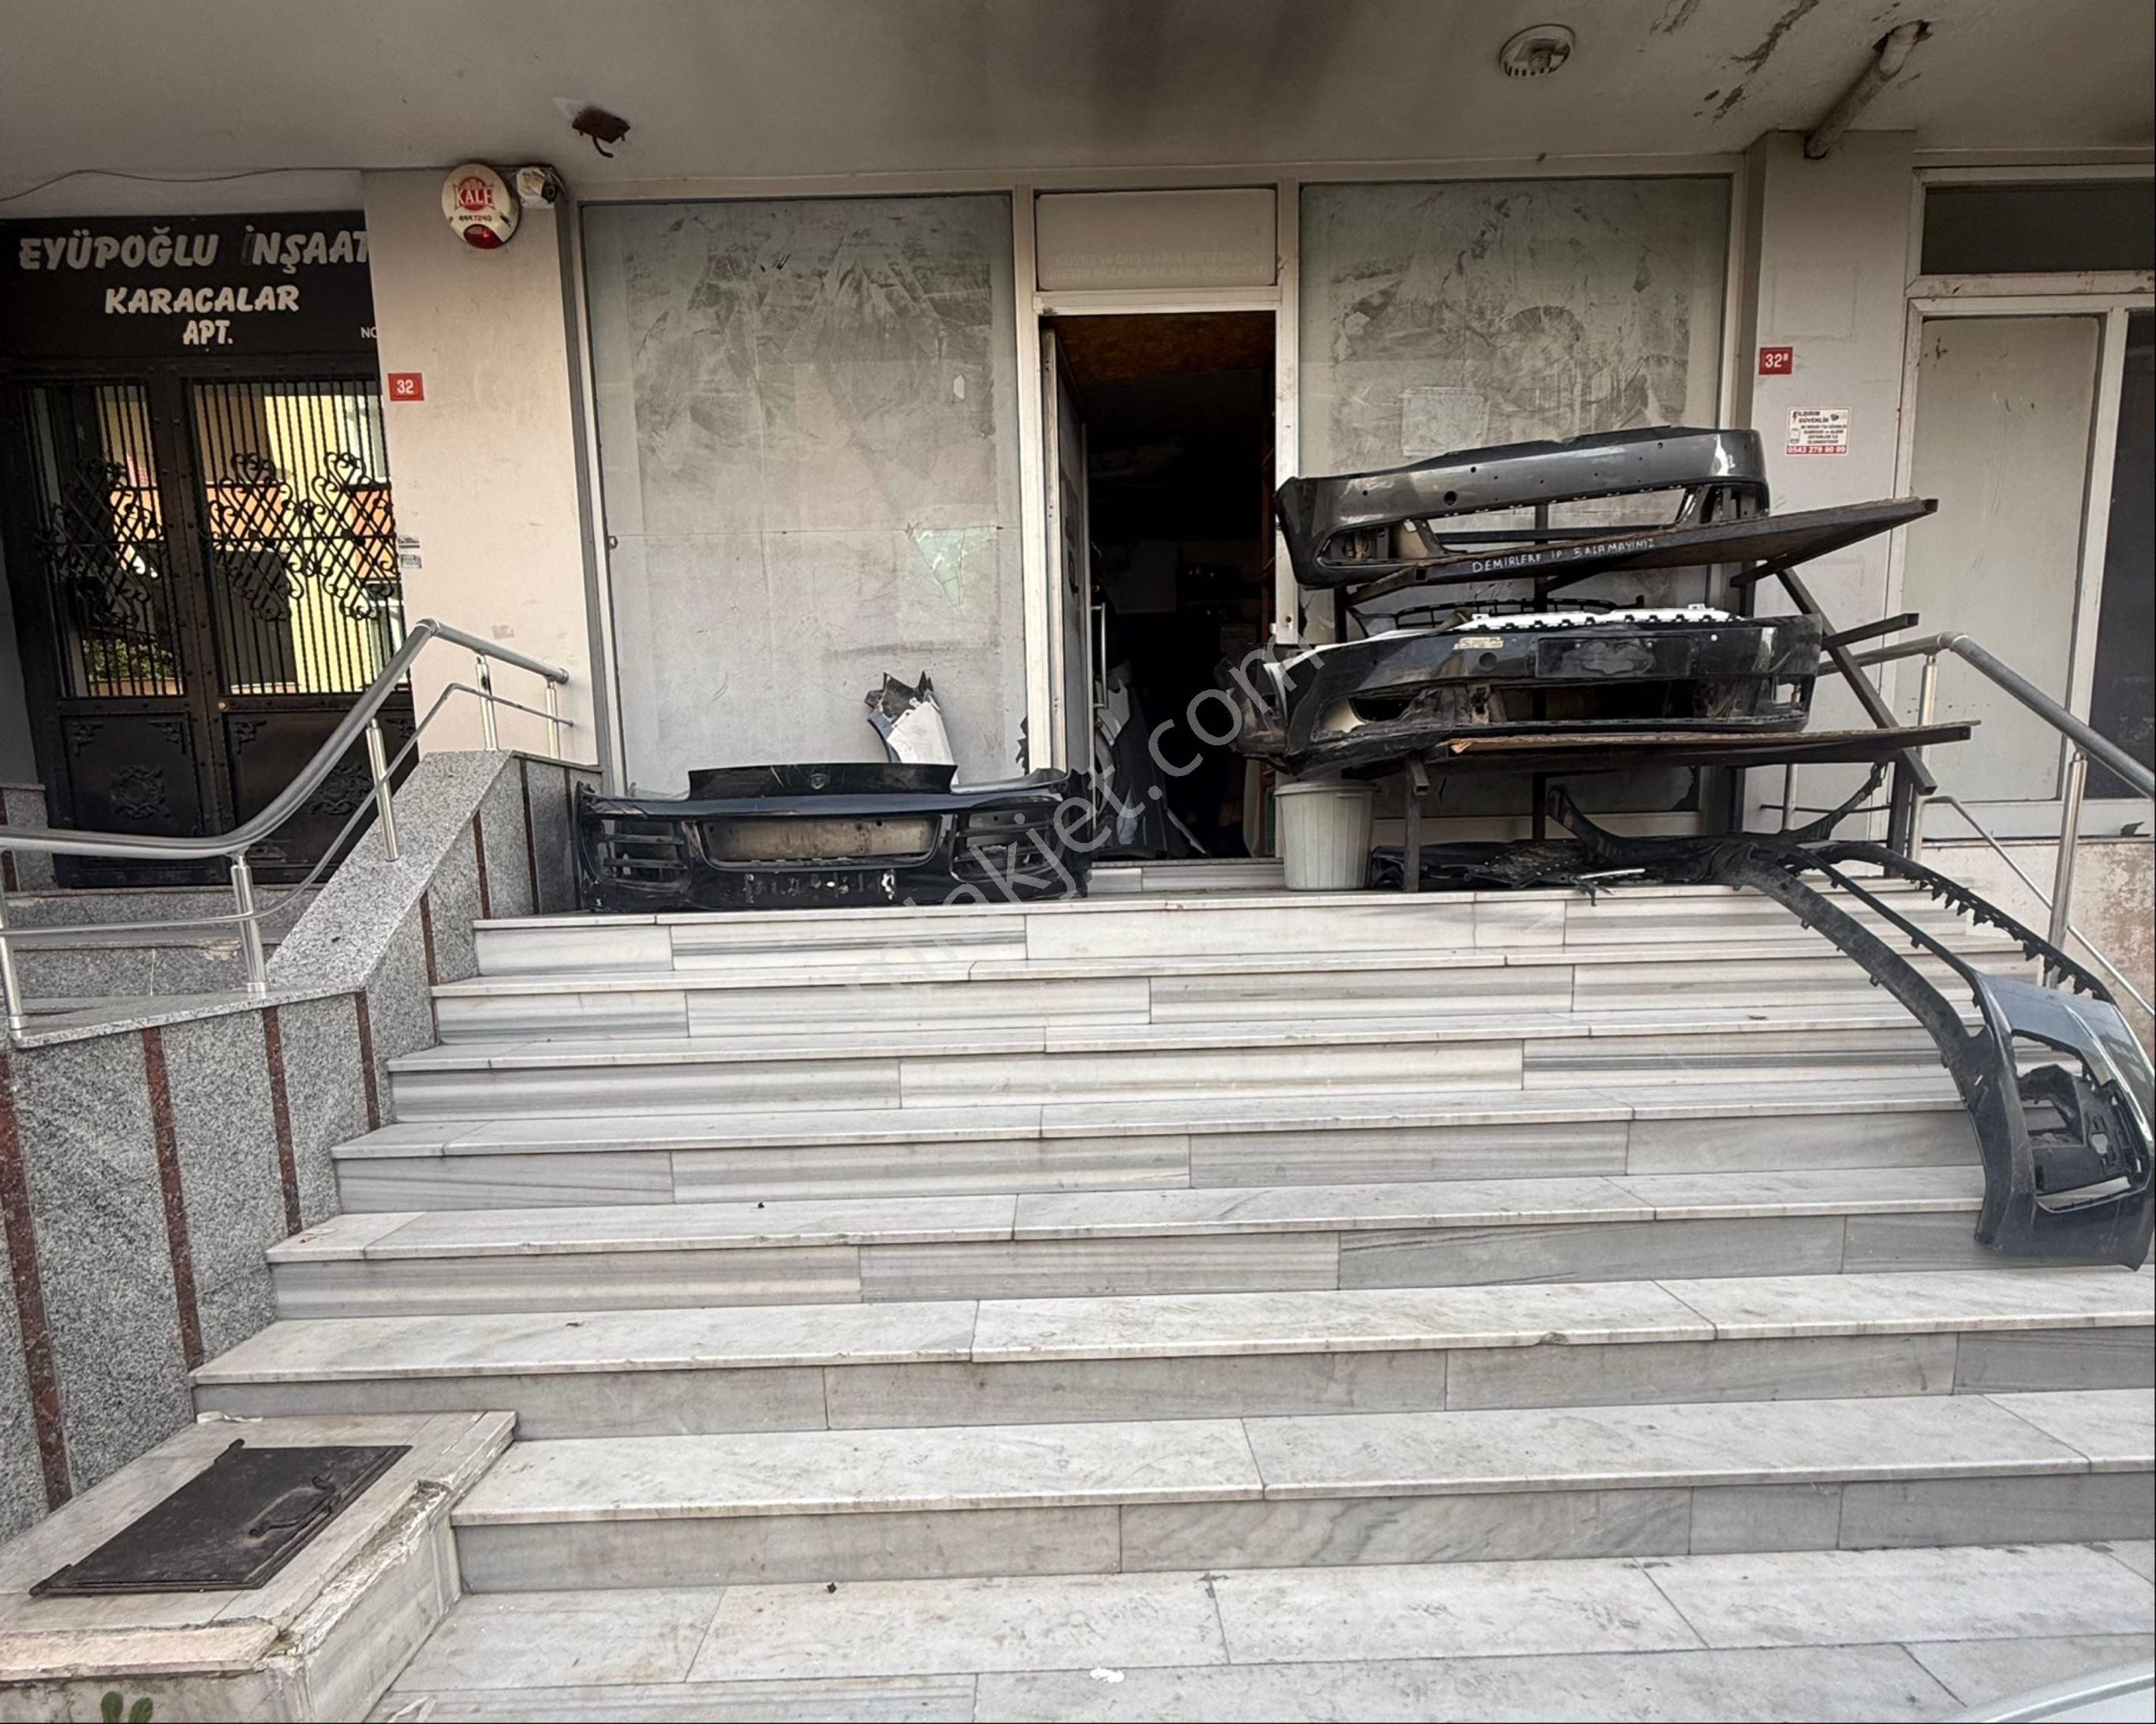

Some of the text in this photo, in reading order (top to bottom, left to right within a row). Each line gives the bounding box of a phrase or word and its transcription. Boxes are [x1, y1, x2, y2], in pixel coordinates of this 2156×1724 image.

[457, 188, 494, 207] KALE
[19, 224, 368, 274] EYÜPOĞLU İNŞAAT
[105, 286, 299, 315] KARACALAR
[183, 319, 234, 345] APT.
[397, 379, 414, 394] 32
